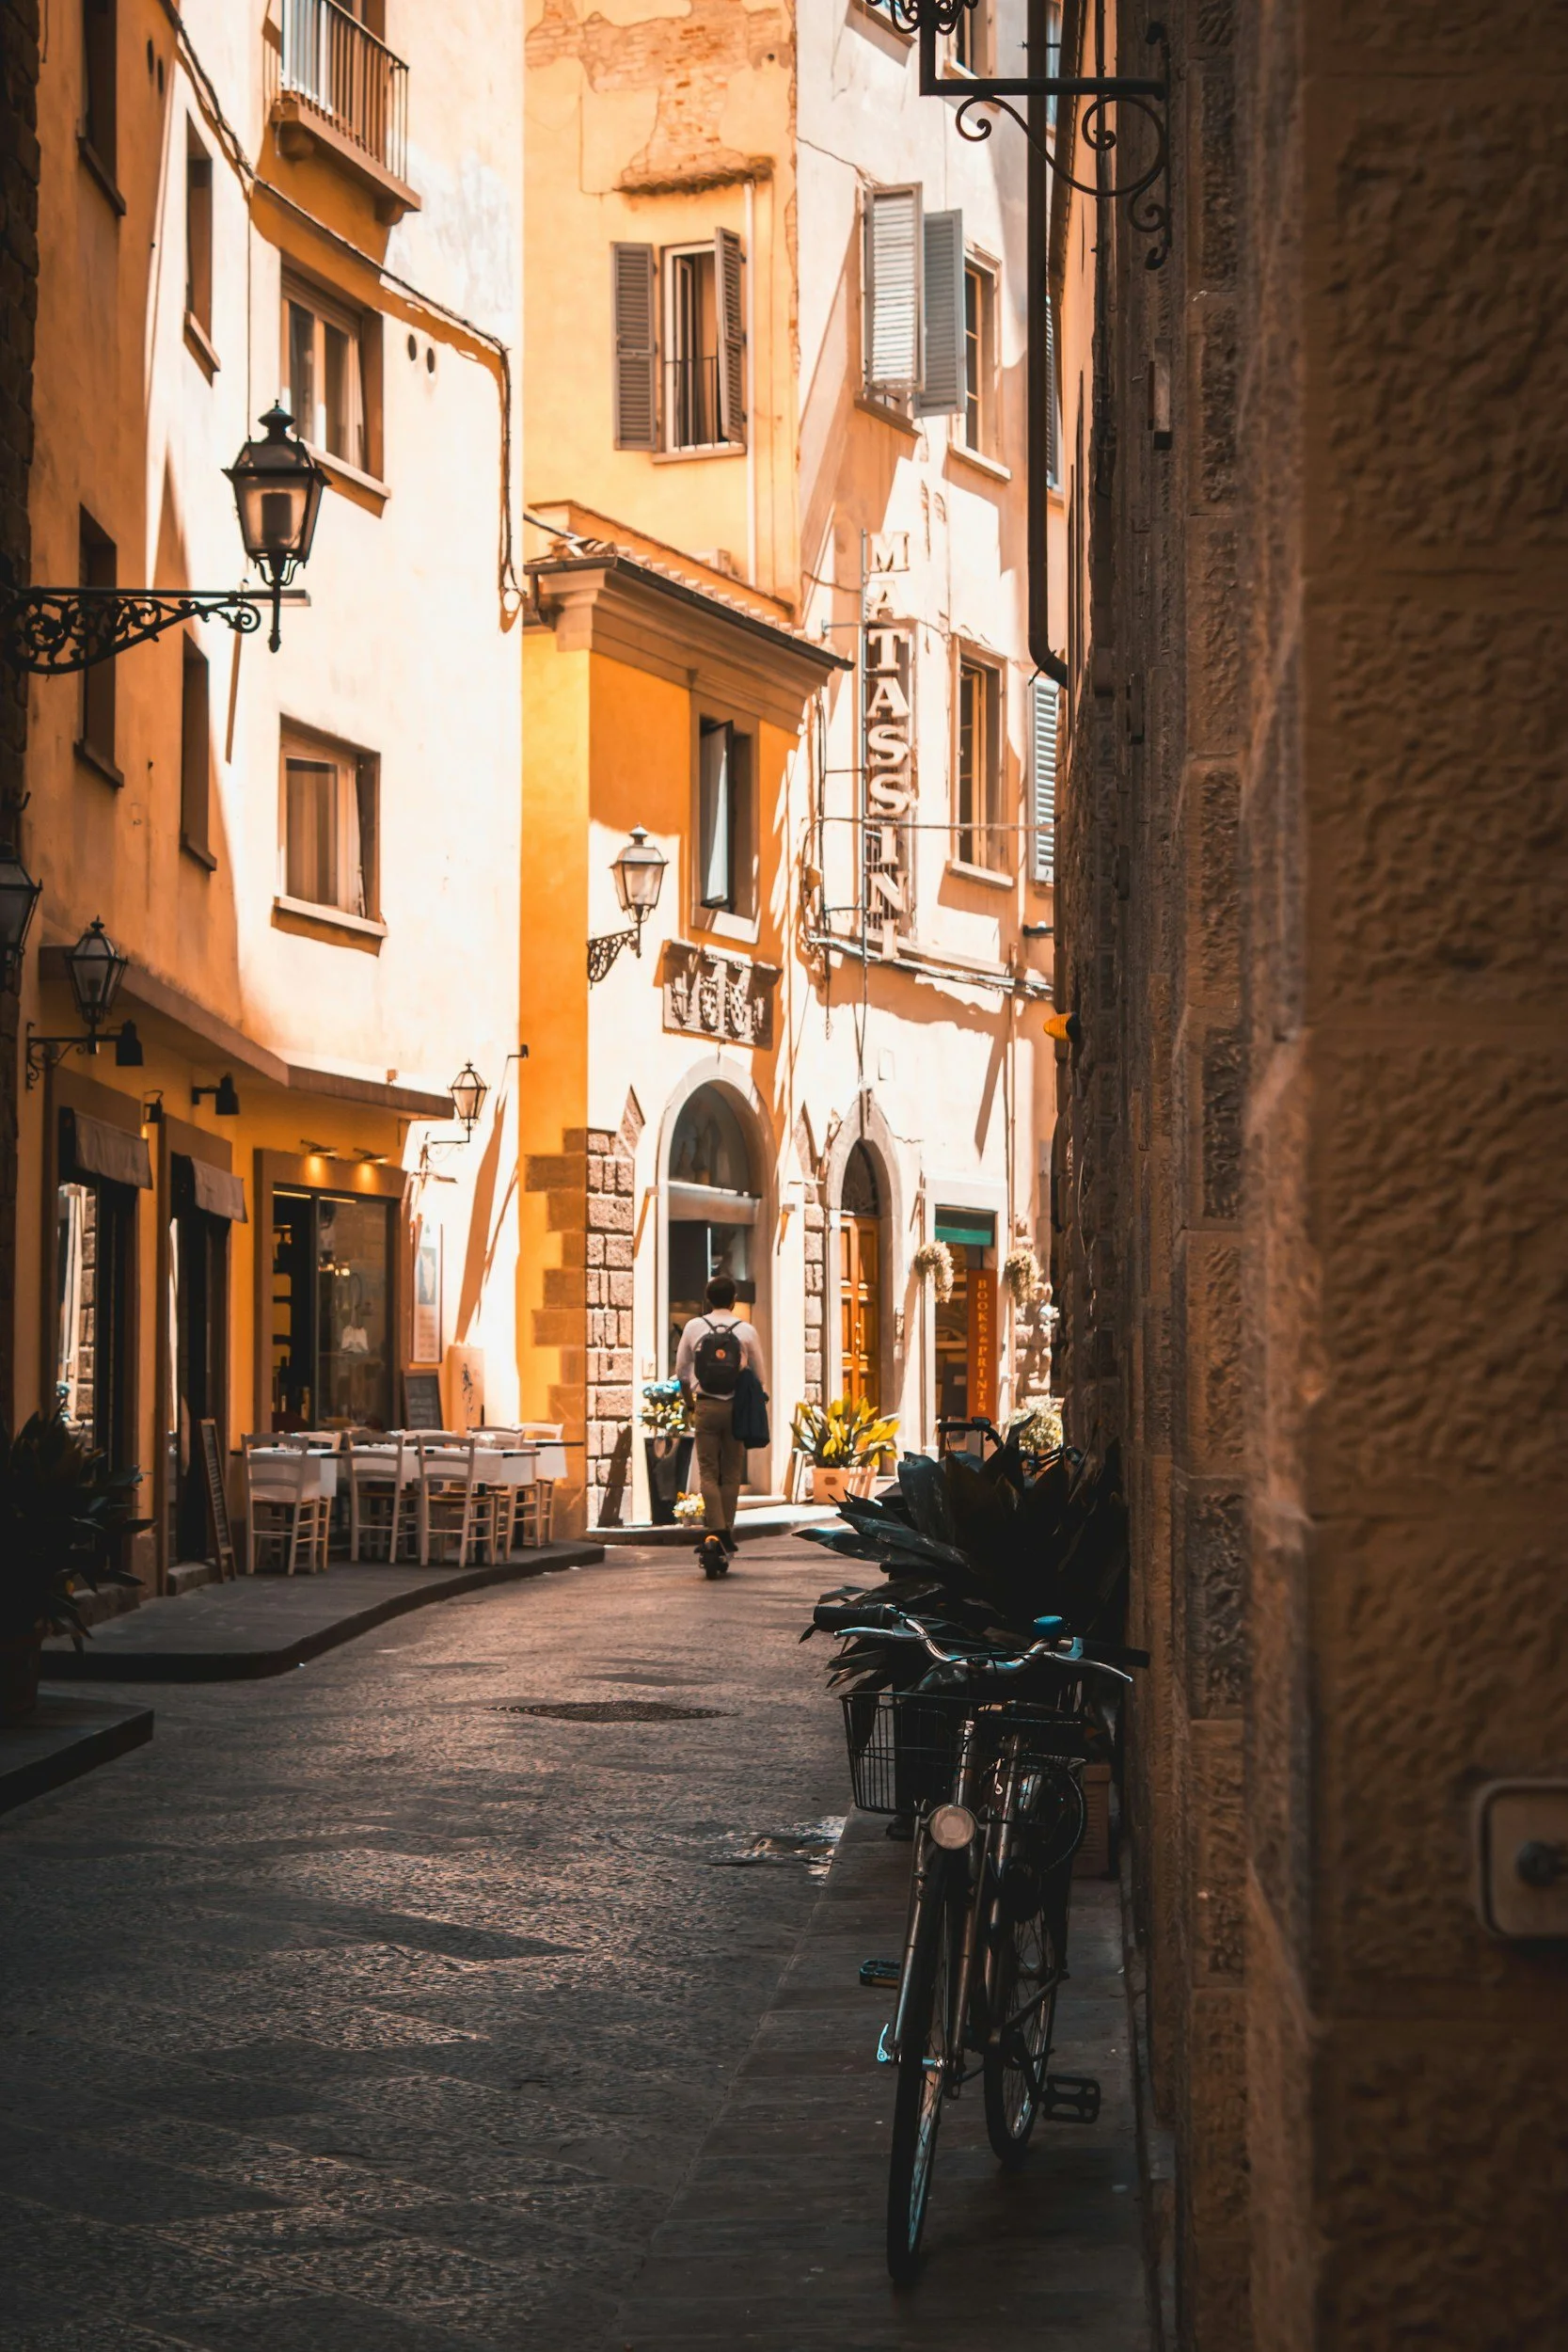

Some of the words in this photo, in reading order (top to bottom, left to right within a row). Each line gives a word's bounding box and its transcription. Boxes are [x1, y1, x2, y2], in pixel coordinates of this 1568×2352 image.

[867, 532, 910, 961] MATASSINI
[976, 1279, 989, 1332] BOOKS
[976, 1346, 989, 1412] PRINTS
